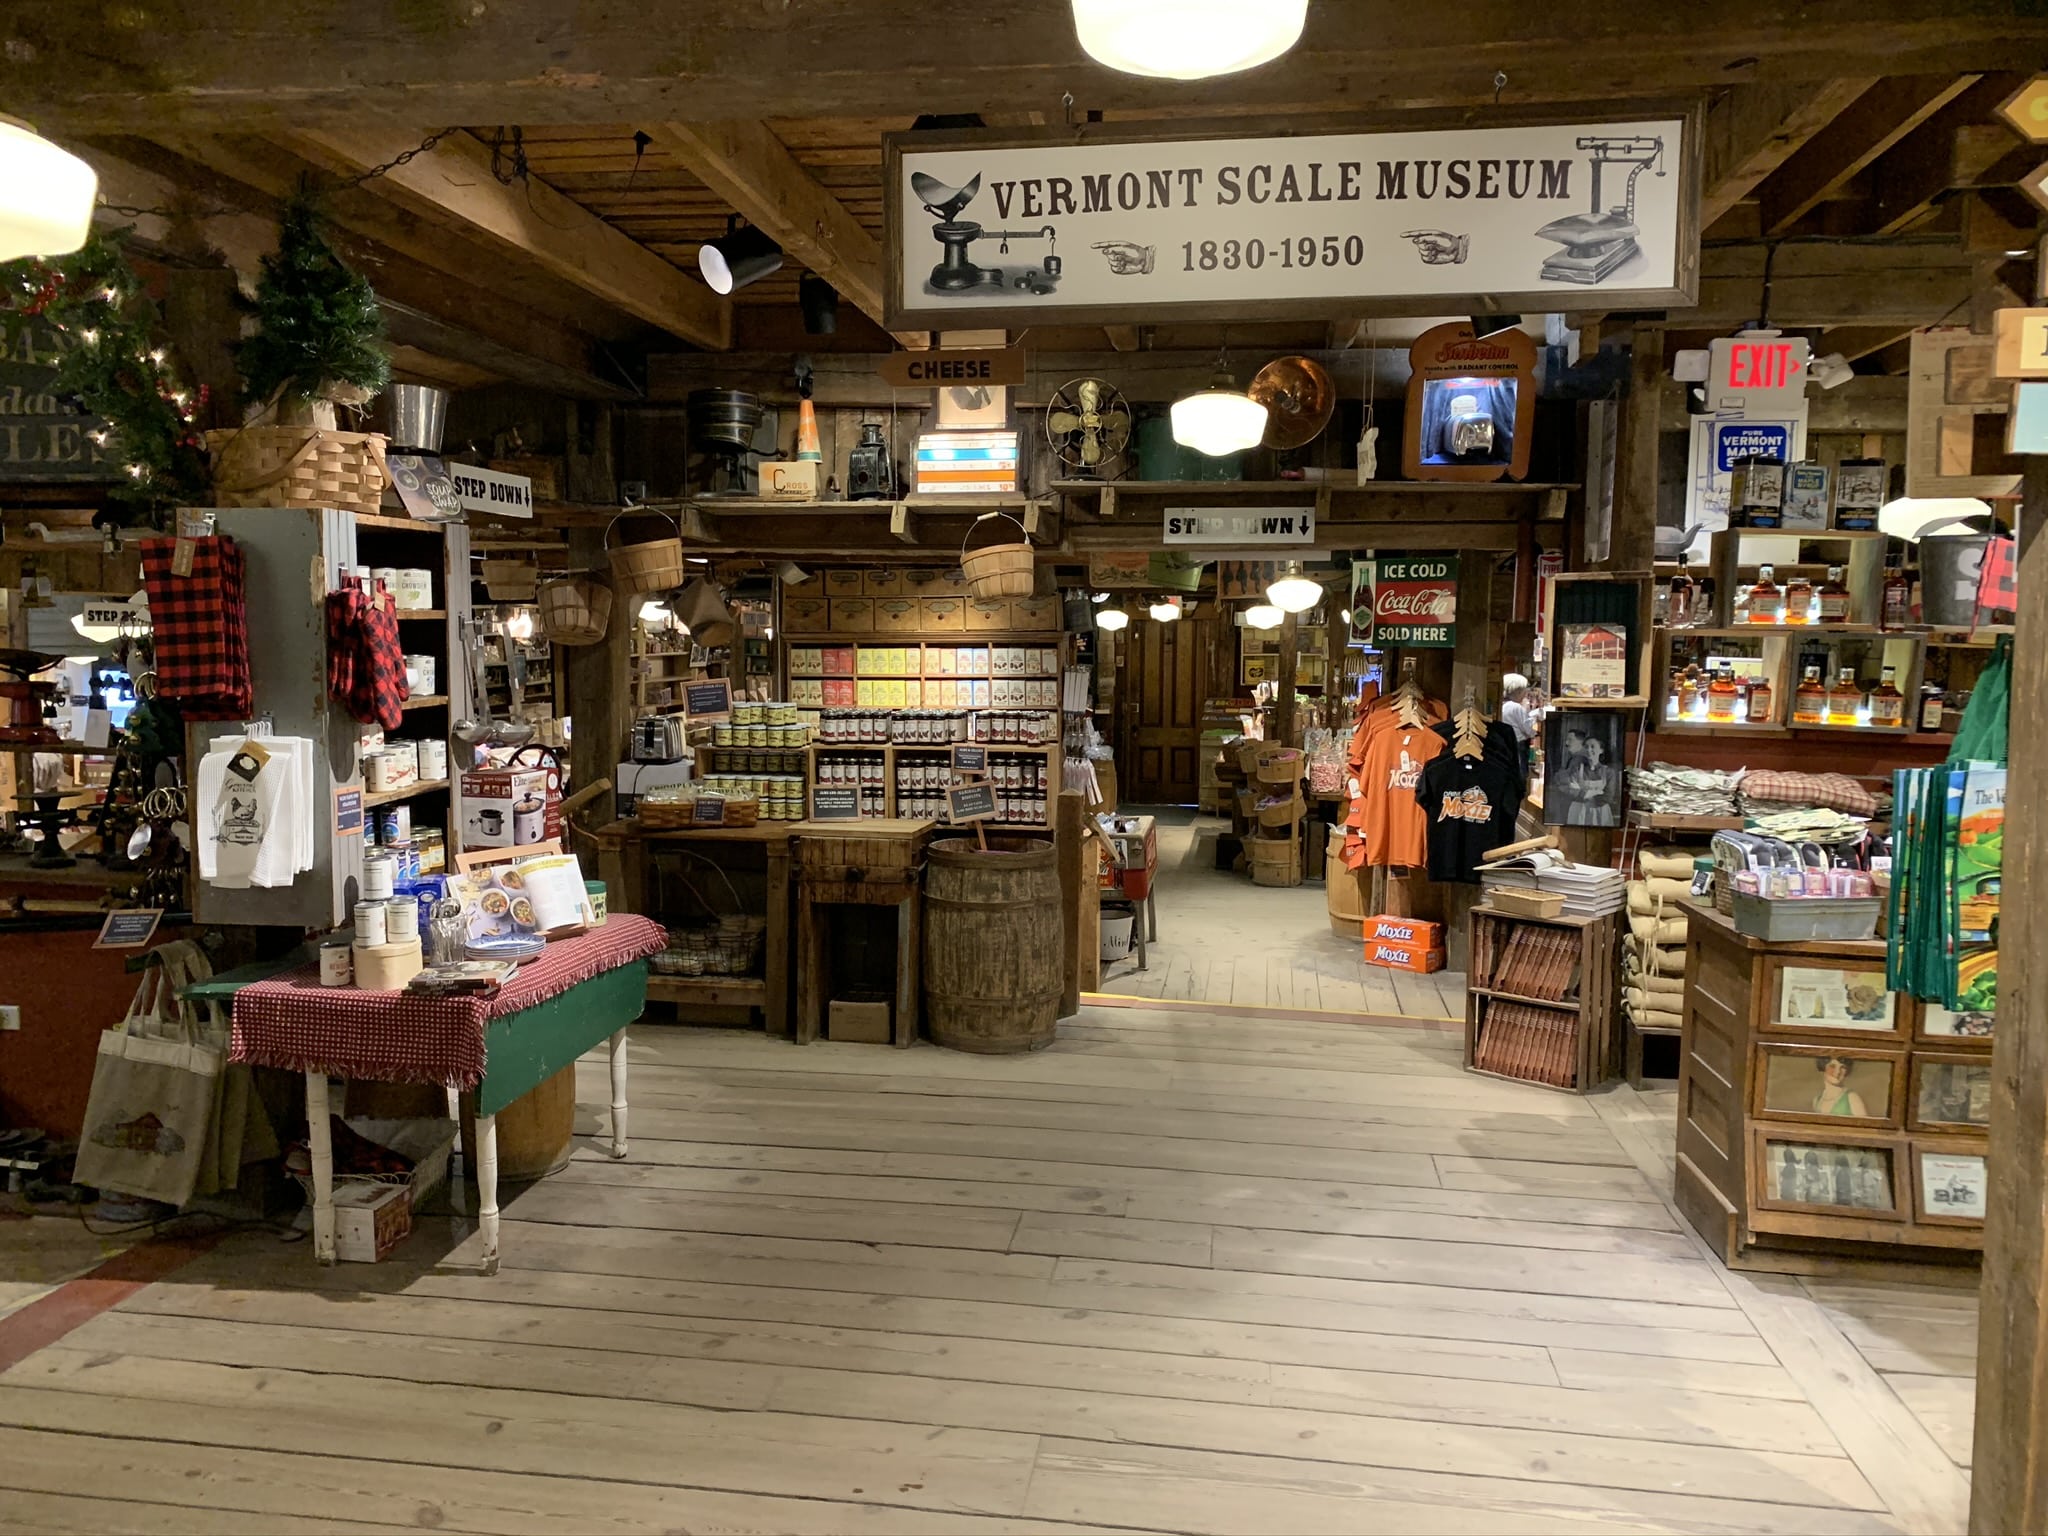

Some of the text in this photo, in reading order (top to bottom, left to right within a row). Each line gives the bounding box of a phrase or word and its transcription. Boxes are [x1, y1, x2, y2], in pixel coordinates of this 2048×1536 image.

[990, 158, 1574, 220] VERMONT SCALE MUSEUM
[1181, 234, 1364, 272] 1830-1950
[908, 360, 991, 380] CHEESE
[1728, 343, 1792, 389] EXIT
[1722, 436, 1783, 446] VERMONT
[454, 475, 523, 505] STEP DOWN
[431, 494, 458, 508] SWAP
[1169, 517, 1293, 534] STEP DOWN
[1384, 563, 1447, 579] ICE COLD
[1543, 564, 1561, 575] FIRE
[1376, 588, 1452, 616] Coca-Cola
[87, 610, 118, 622] STEP
[1378, 627, 1448, 641] SOLD HERE
[1975, 789, 1993, 805] The
[1438, 797, 1493, 823] MOXIE
[1373, 923, 1413, 940] MOXIE
[1374, 946, 1410, 963] MOXIE
